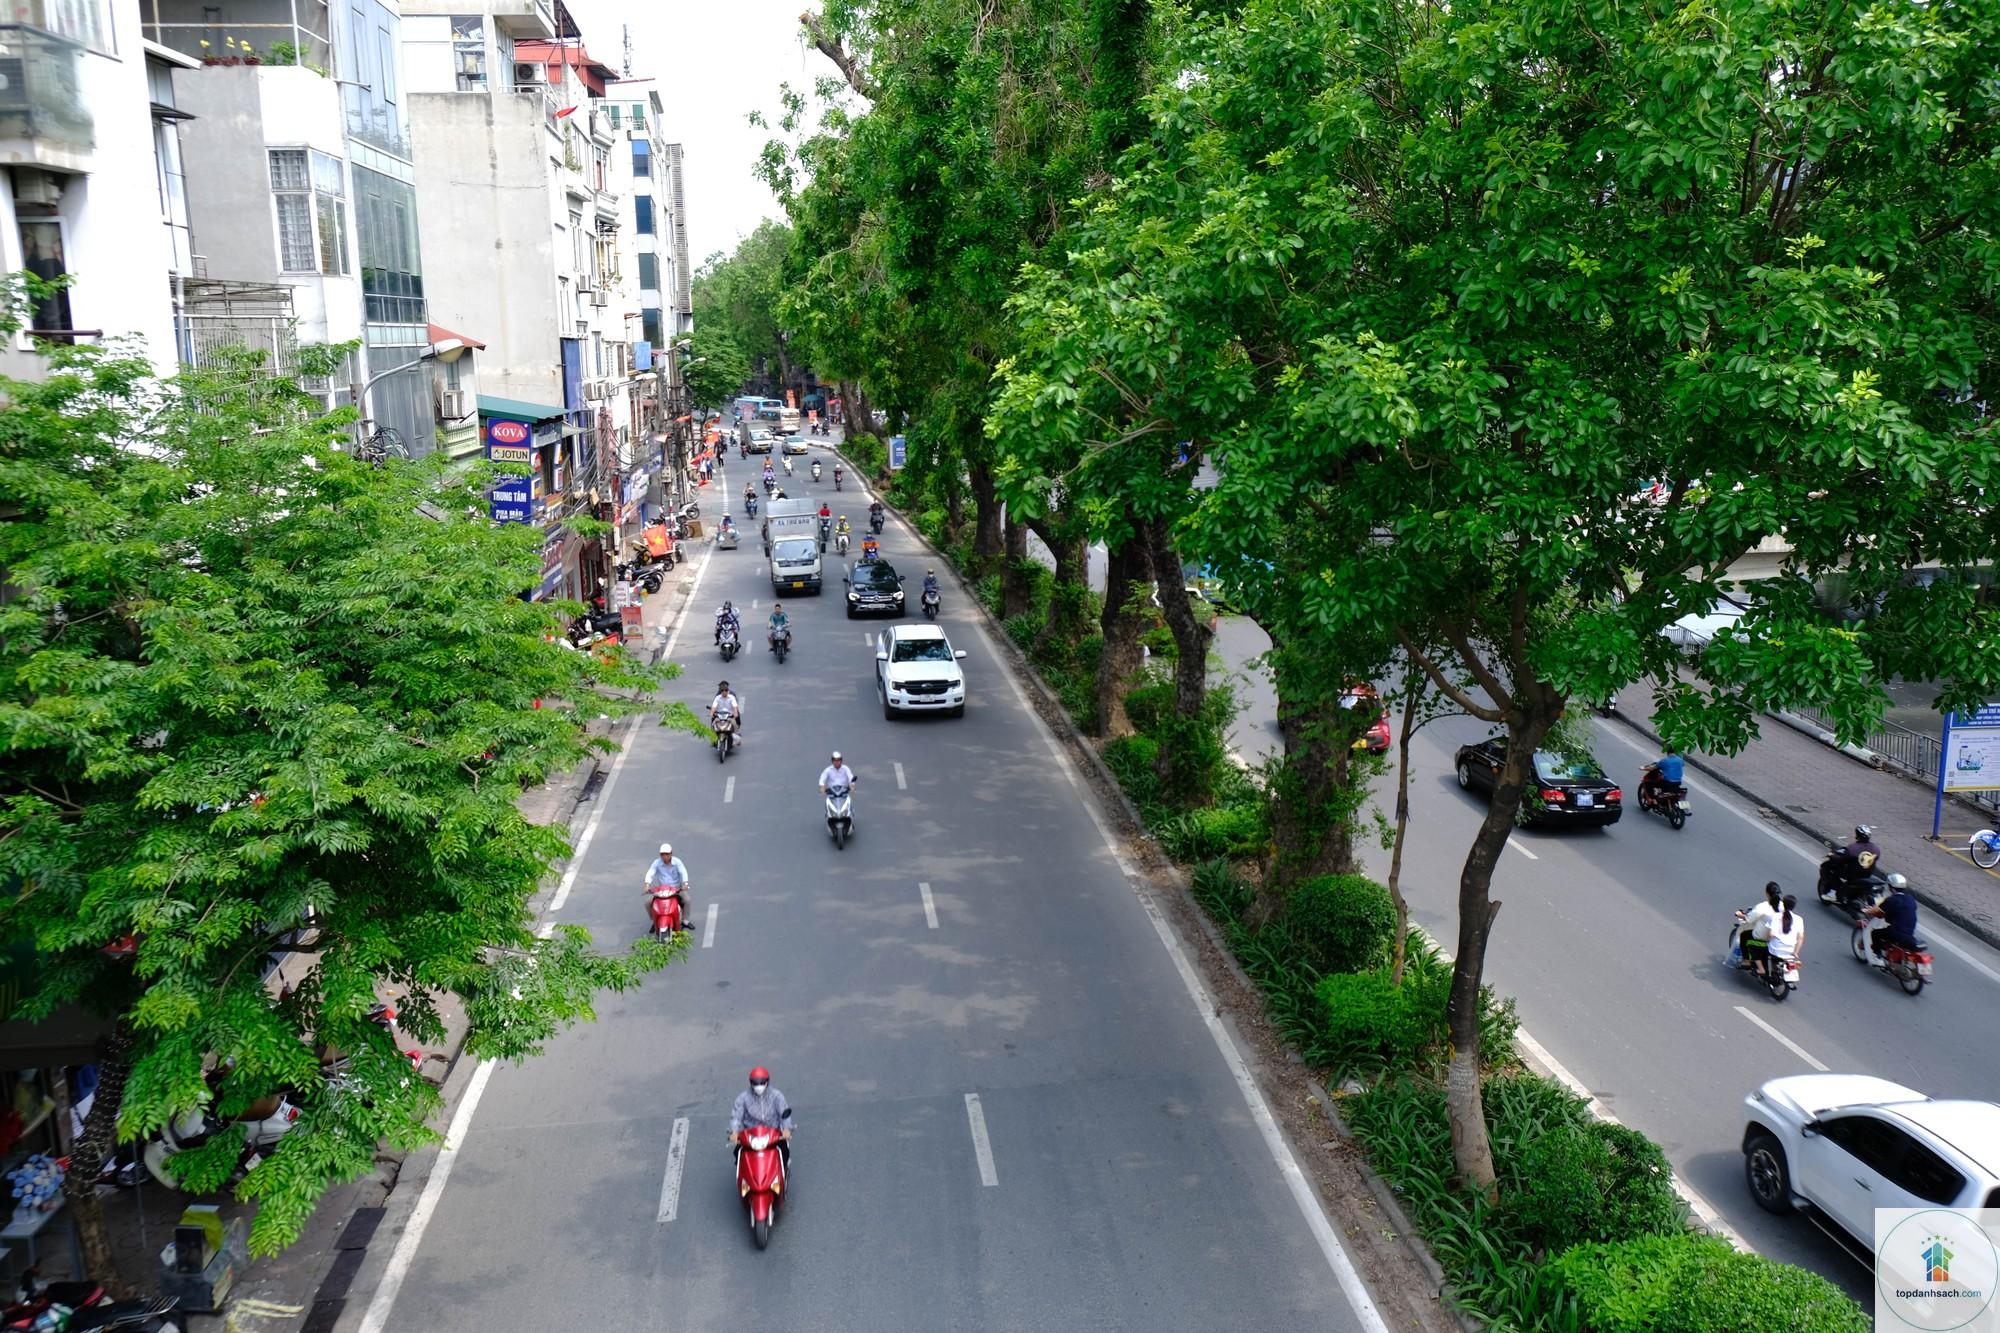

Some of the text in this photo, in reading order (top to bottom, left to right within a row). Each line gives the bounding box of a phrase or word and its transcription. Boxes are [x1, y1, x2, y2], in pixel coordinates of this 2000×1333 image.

[494, 427, 524, 438] KOVA
[501, 450, 528, 460] JOTUN
[492, 491, 513, 502] TRUNG
